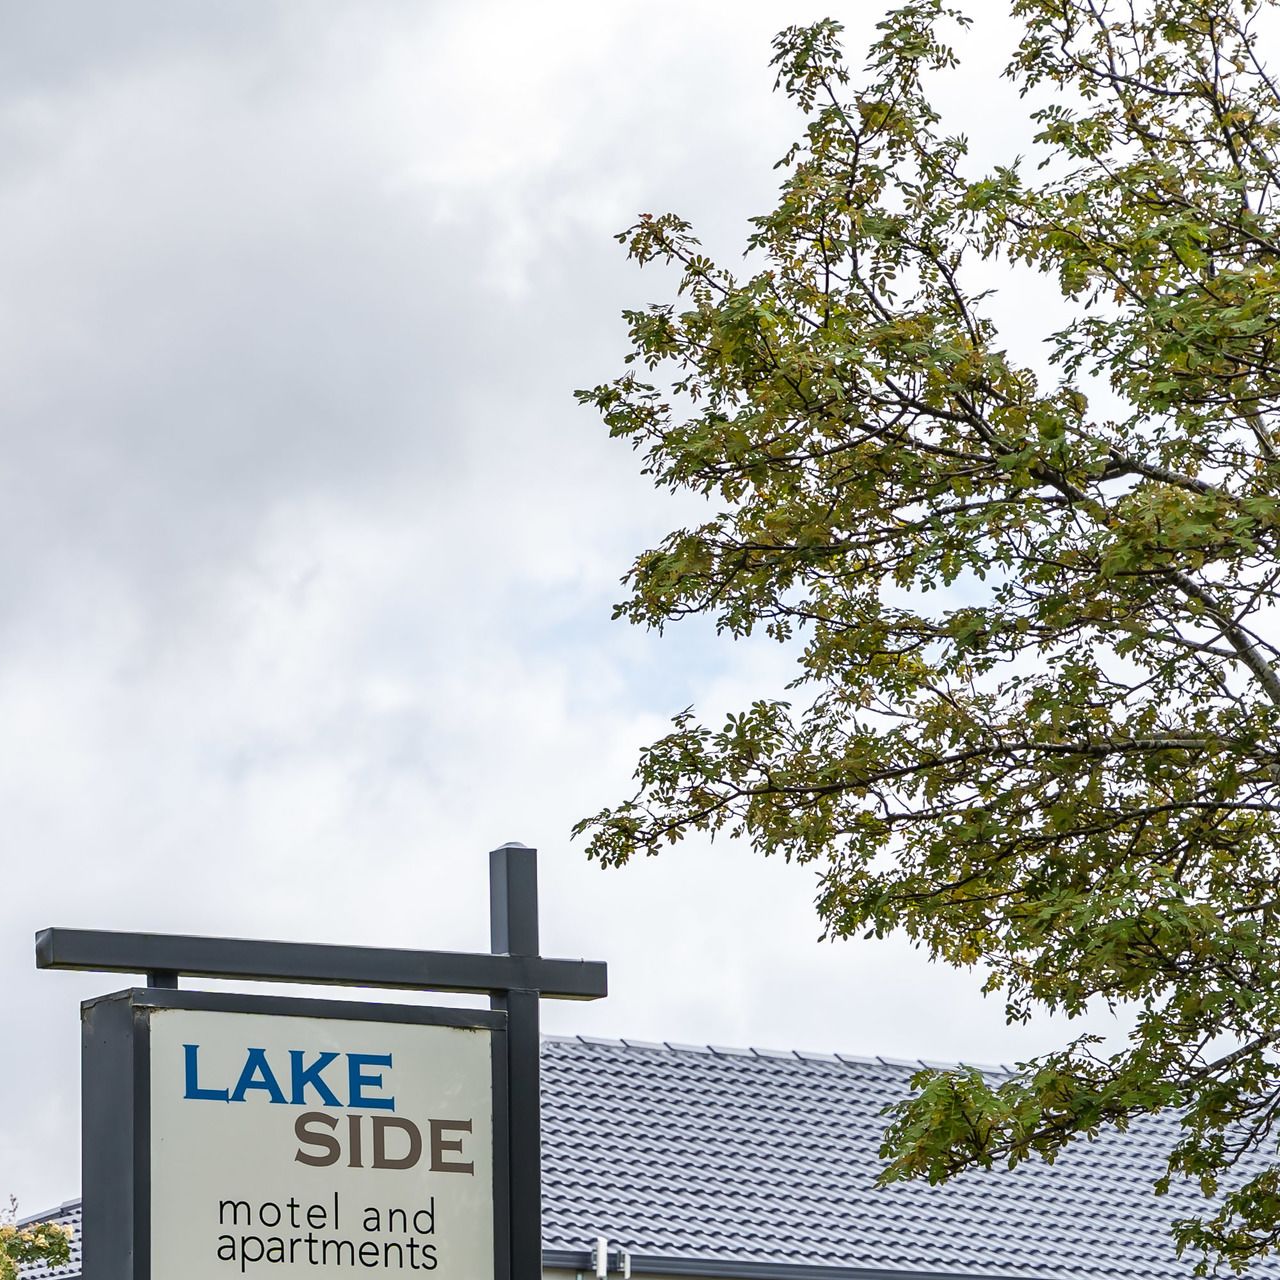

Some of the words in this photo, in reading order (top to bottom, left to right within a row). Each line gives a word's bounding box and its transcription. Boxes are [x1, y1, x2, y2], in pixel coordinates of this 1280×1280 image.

[182, 1044, 396, 1112] LAKE
[294, 1111, 475, 1177] SIDE
[218, 1191, 339, 1230] motel
[362, 1196, 435, 1235] and
[217, 1232, 438, 1273] apartments
